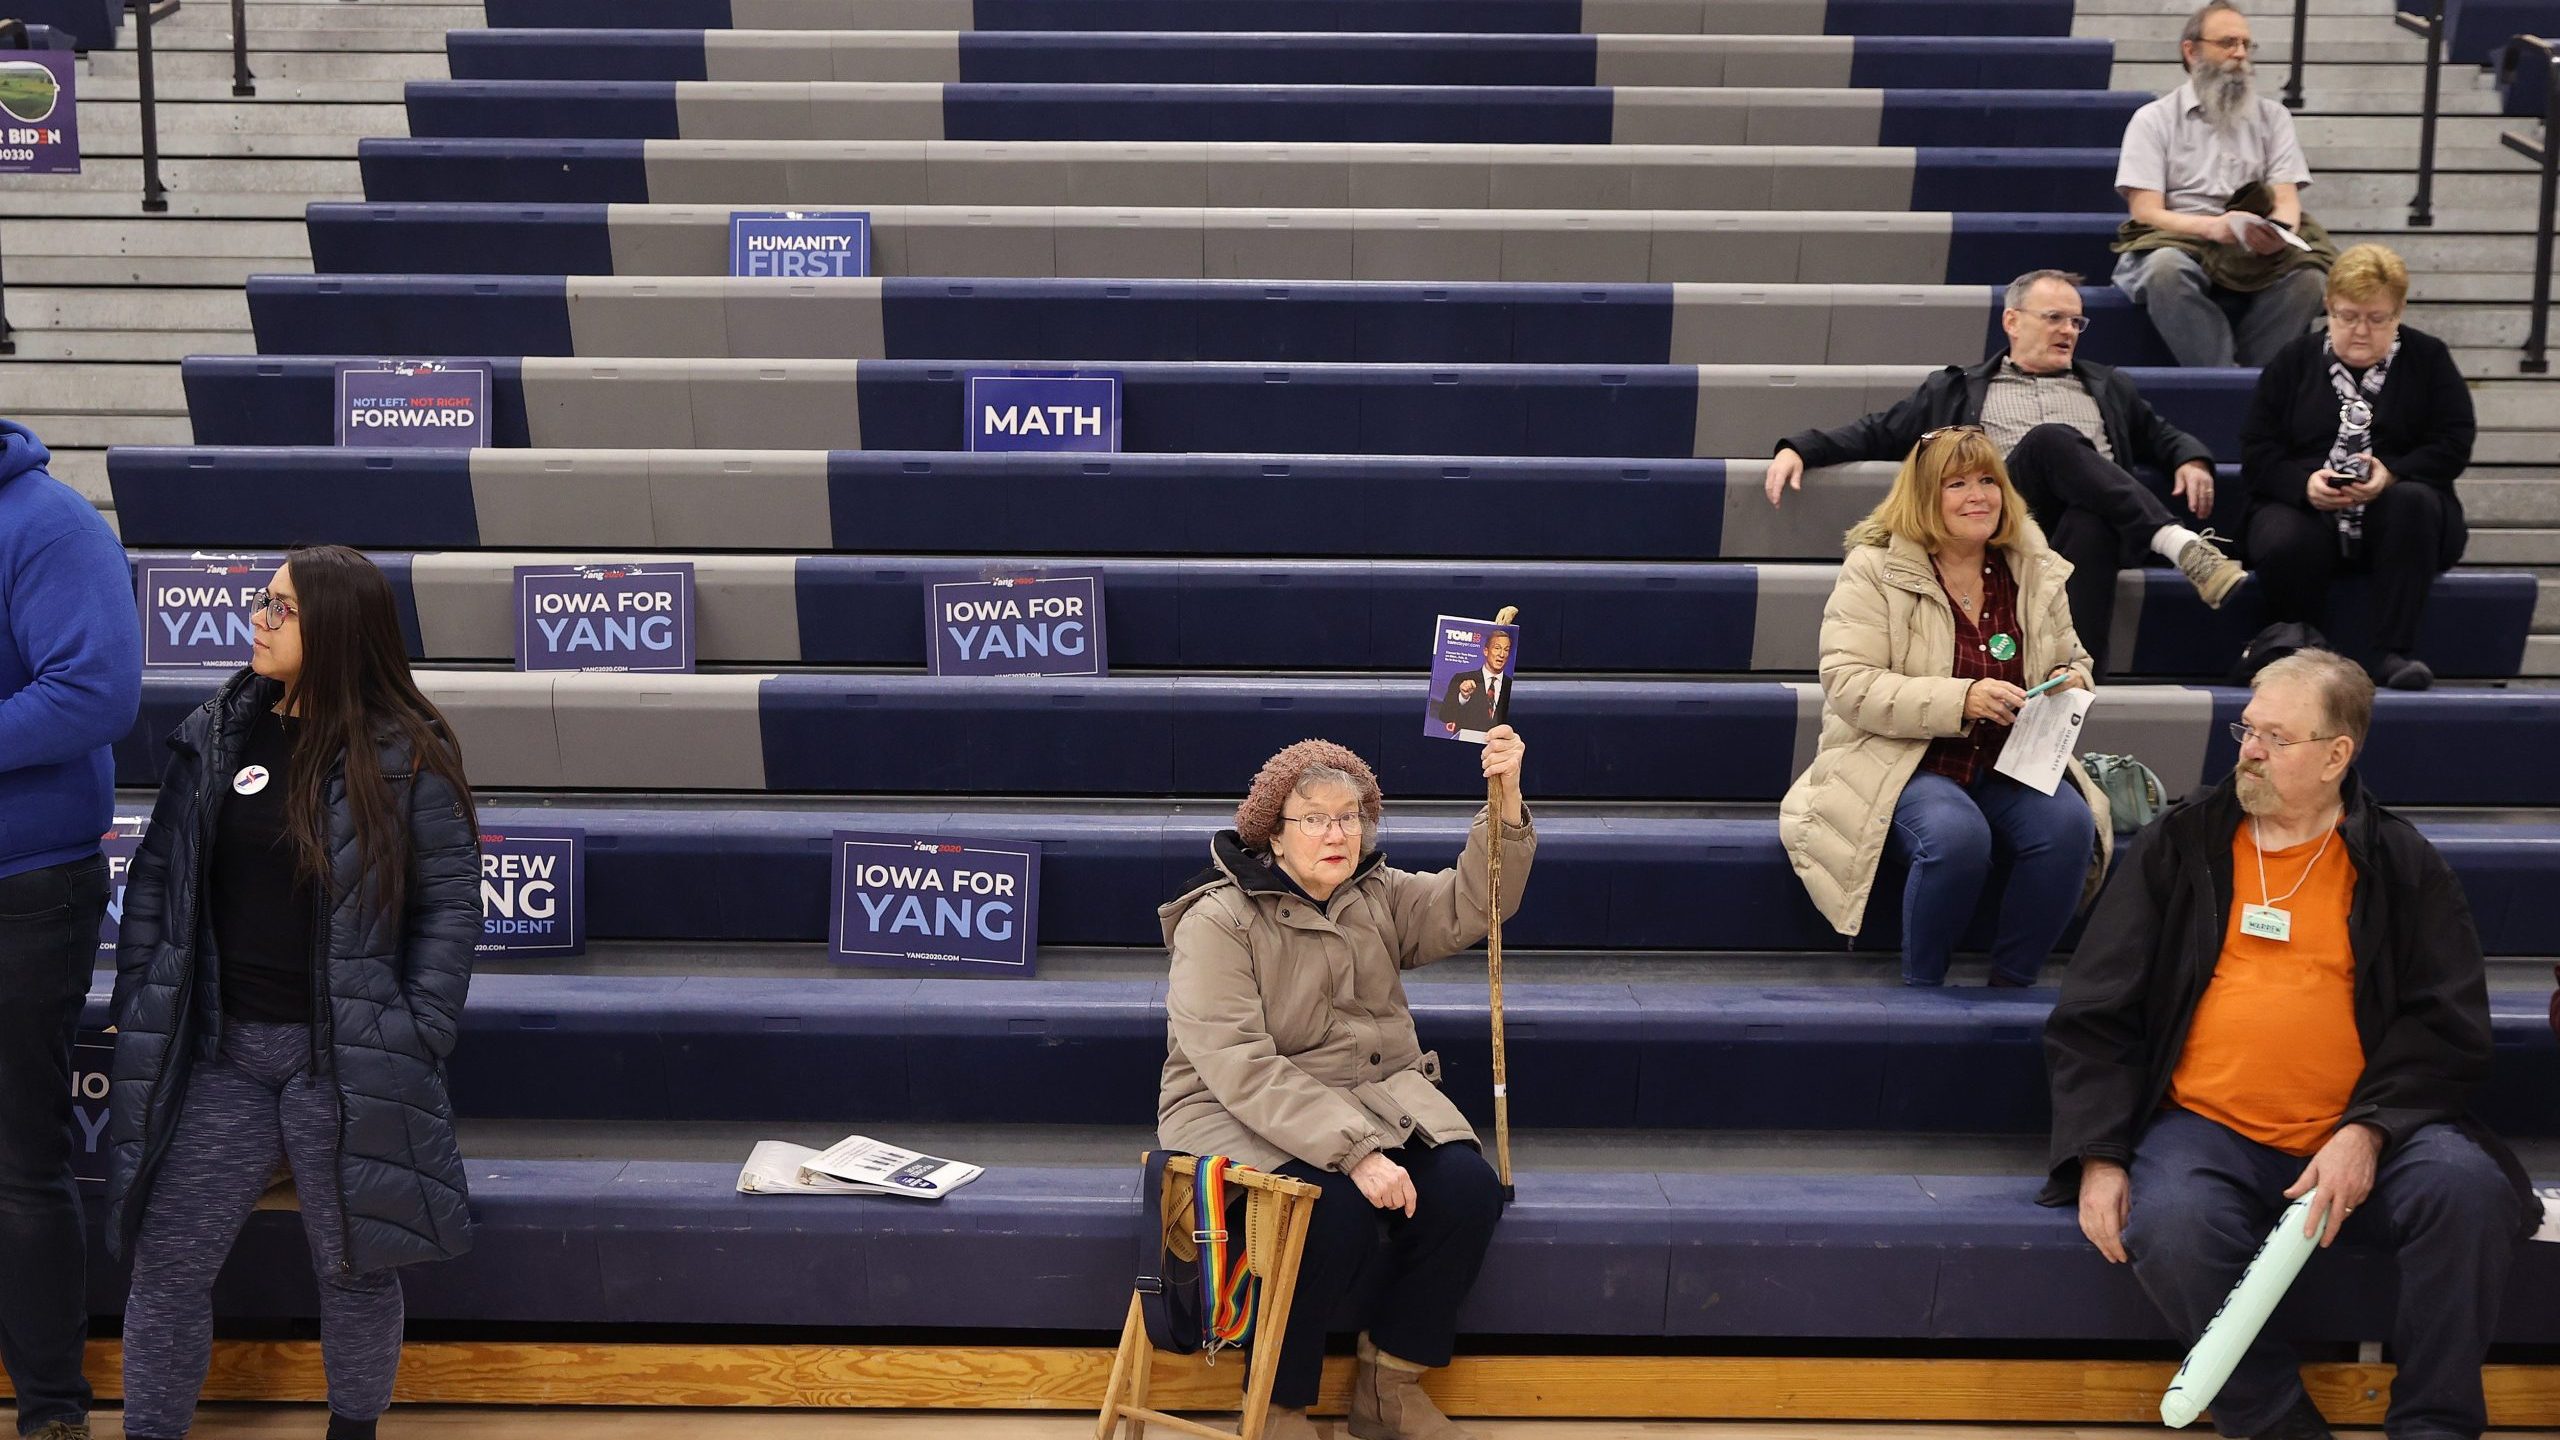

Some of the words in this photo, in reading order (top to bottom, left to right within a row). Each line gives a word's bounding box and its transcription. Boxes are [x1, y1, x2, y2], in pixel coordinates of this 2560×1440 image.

[9, 128, 61, 145] BIDEN
[748, 236, 851, 250] HUMANITY
[749, 251, 851, 277] FIRST
[353, 398, 377, 407] NOT
[379, 398, 408, 407] LEFT.
[410, 398, 434, 407] NOT
[436, 398, 472, 407] RIGHT.
[352, 409, 475, 427] FORWARD
[985, 405, 1101, 435] MATH
[158, 587, 233, 607] IOWA
[535, 593, 611, 614] IOWA
[618, 591, 672, 612] FOR
[946, 600, 1022, 622] IOWA
[1029, 597, 1083, 619] FOR
[159, 611, 254, 646] YAN
[536, 615, 673, 652] YANG
[948, 621, 1085, 660] YANG
[1446, 629, 1473, 643] TOM
[480, 854, 556, 879] REW
[856, 864, 944, 892] IOWA
[953, 870, 1014, 897] FOR
[480, 879, 555, 919] NG
[484, 920, 555, 934] SIDENT
[857, 893, 1014, 942] YANG
[906, 952, 960, 962] YANG2020.COM
[72, 1072, 110, 1099] IO
